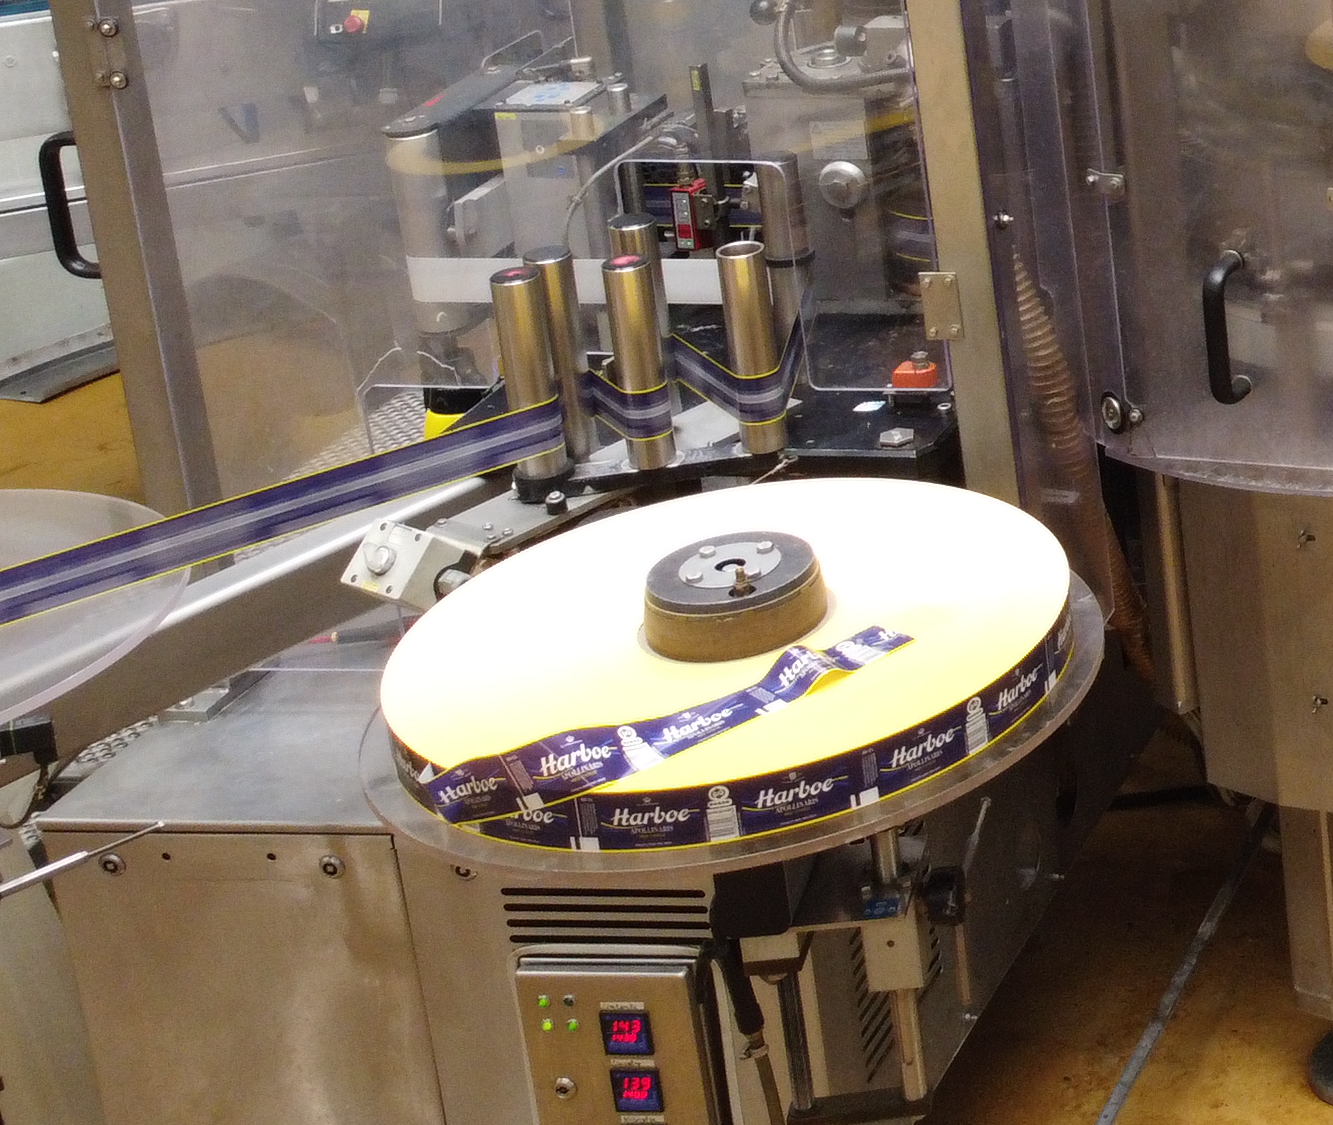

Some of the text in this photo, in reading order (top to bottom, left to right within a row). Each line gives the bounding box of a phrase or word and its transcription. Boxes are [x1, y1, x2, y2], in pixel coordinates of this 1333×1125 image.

[997, 667, 1038, 711] Harboe
[661, 707, 733, 744] Harboe
[540, 742, 612, 777] Harboe
[890, 728, 956, 768] Harboe
[438, 775, 498, 804] Harboe
[755, 777, 835, 809] Harboe
[611, 806, 691, 826] Harboe
[612, 1020, 641, 1033] 143
[623, 1077, 652, 1091] 139
